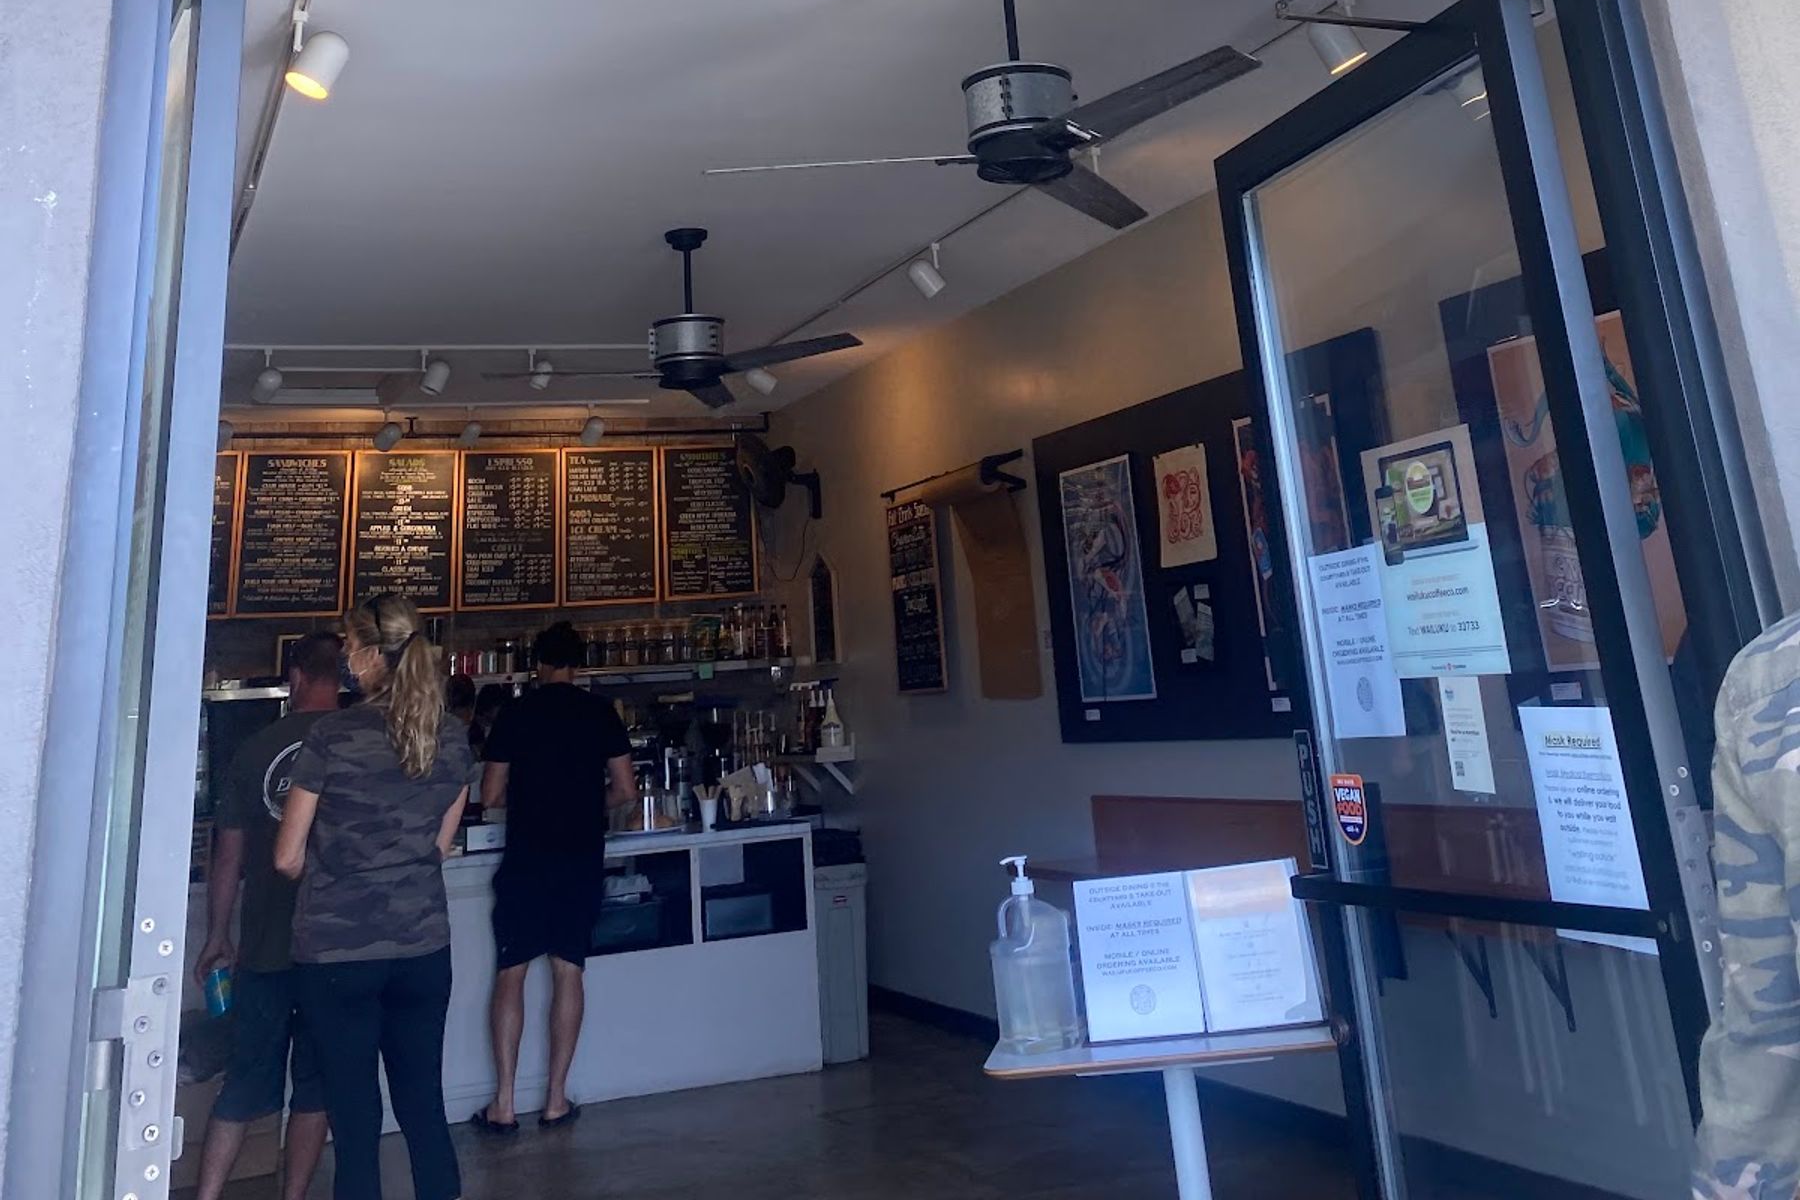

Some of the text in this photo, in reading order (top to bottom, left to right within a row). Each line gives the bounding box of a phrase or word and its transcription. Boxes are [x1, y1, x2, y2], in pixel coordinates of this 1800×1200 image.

[569, 456, 586, 465] TEA
[1420, 623, 1449, 634] WAILUKU
[1545, 735, 1600, 748] Mask Required
[1577, 785, 1595, 794] online
[1298, 743, 1321, 854] PUSH
[1334, 787, 1361, 804] VEGAN
[1574, 798, 1593, 807] deliver
[1336, 801, 1362, 816] FOOD
[1576, 811, 1591, 820] while
[1592, 813, 1604, 822] you
[1110, 901, 1152, 910] AVAILABLE
[1121, 930, 1136, 938] ALL
[1104, 950, 1134, 960] MOBILE
[1141, 948, 1170, 957] ONLINE
[1096, 956, 1180, 969] ORDERING AVAILABLE
